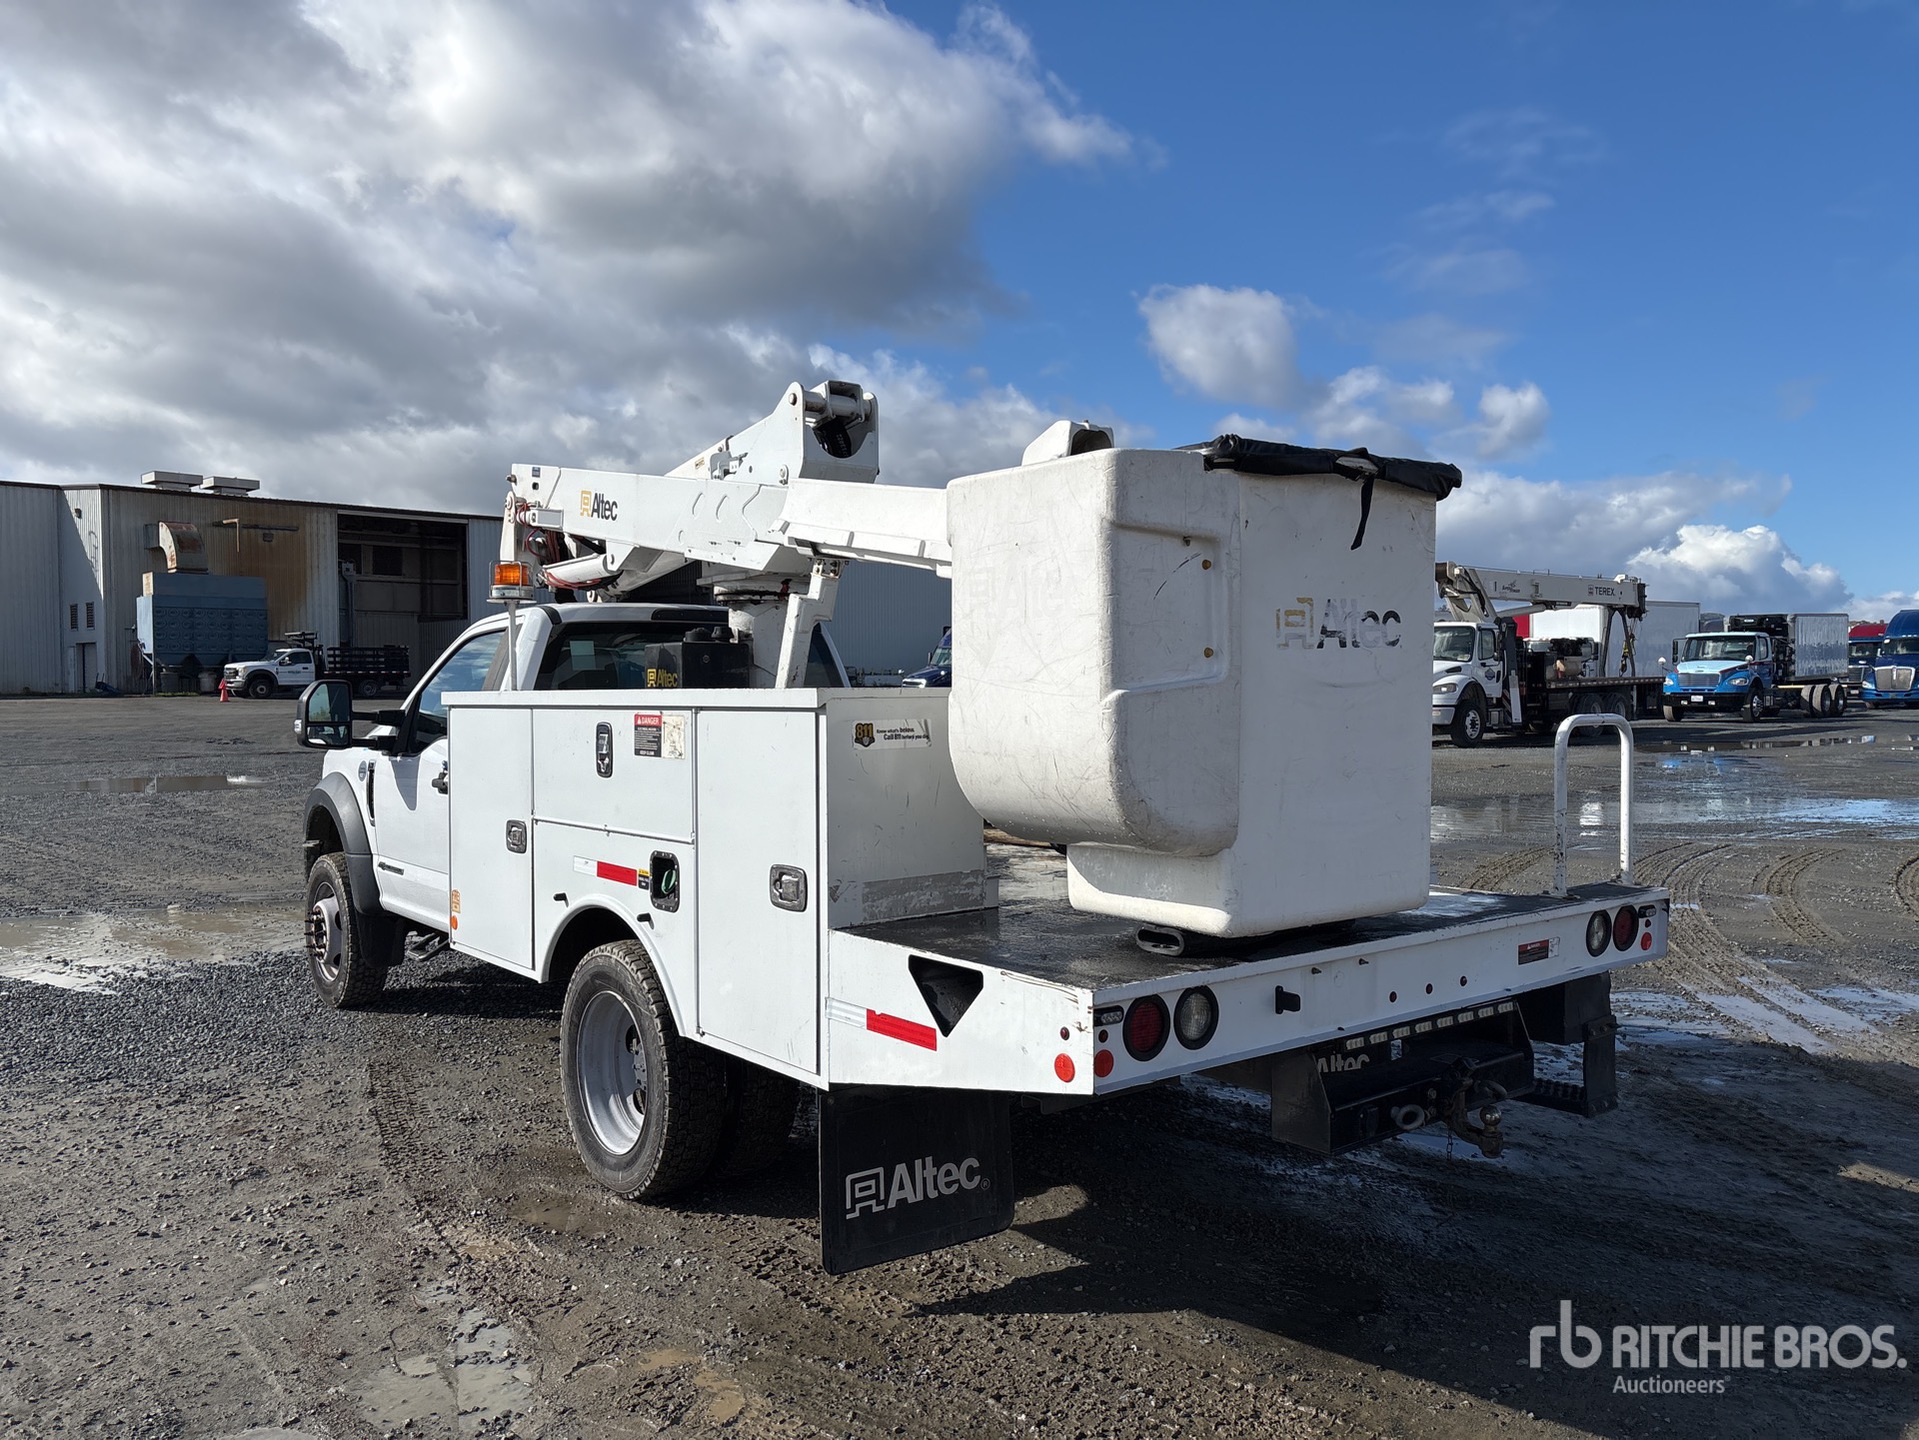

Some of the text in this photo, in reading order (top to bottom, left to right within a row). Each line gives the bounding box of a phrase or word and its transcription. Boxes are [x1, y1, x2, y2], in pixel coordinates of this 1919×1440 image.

[591, 492, 618, 521] Altec
[1594, 586, 1615, 596] TEREX
[656, 668, 678, 688] Altec
[856, 722, 873, 739] 811
[887, 1155, 981, 1209] Altec
